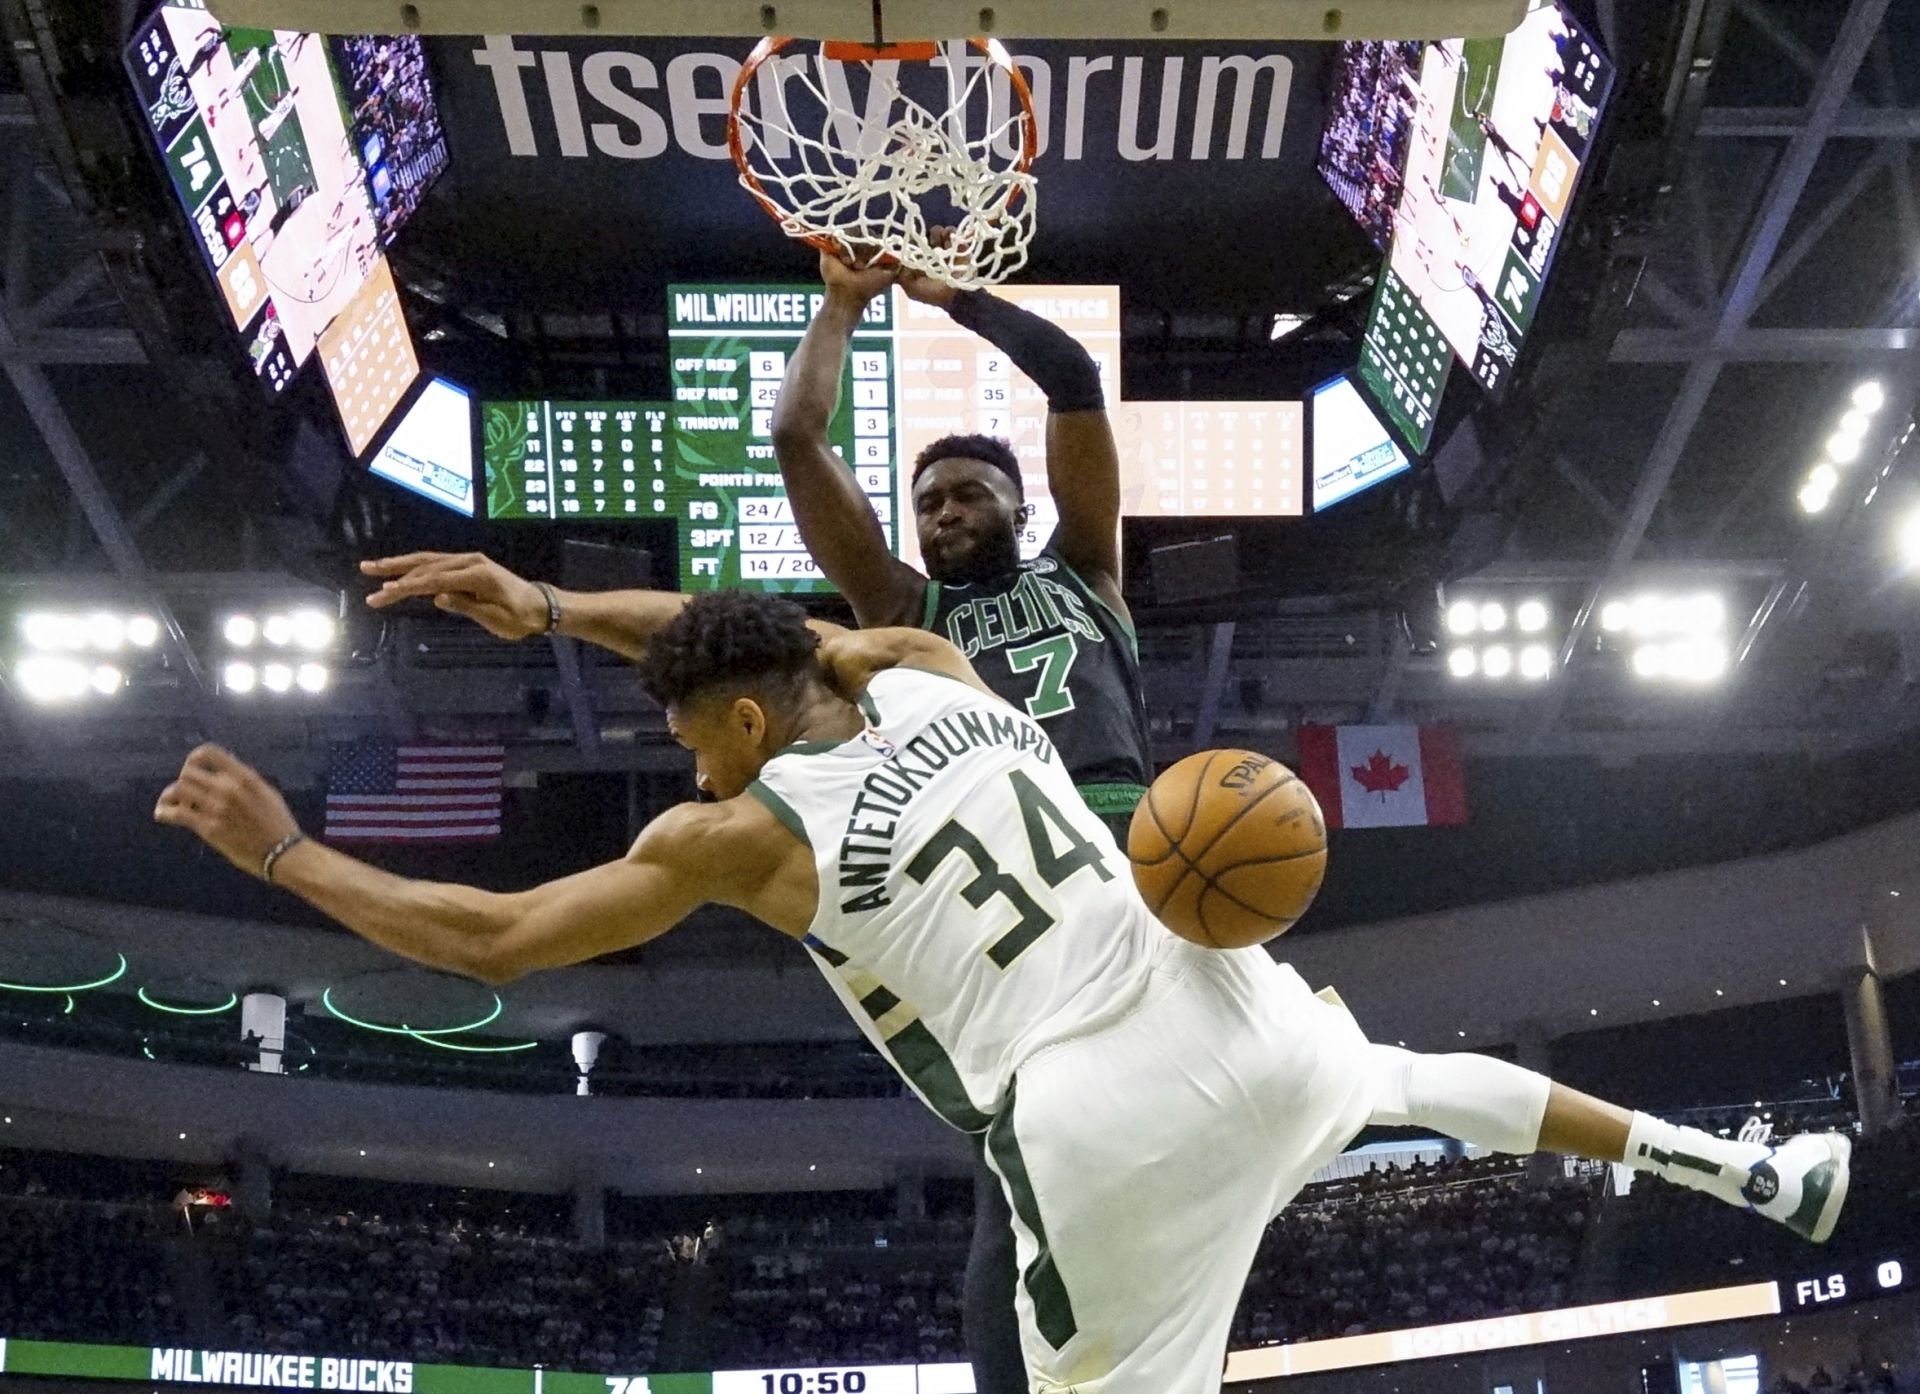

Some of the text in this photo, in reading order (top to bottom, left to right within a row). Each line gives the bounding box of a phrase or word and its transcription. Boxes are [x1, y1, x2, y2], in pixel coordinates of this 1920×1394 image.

[472, 35, 1294, 162] fiserv forum
[180, 135, 212, 192] 74
[197, 205, 228, 267] 10:50
[1528, 215, 1555, 274] 10:50
[1503, 266, 1530, 314] 74
[675, 293, 806, 322] MILWAUKEE
[675, 358, 704, 372] OFF
[762, 361, 773, 372] 6
[862, 361, 879, 372] 15
[988, 361, 998, 372] 2
[868, 390, 874, 400] 1
[984, 389, 1004, 400] 35
[867, 418, 877, 430] 3
[991, 418, 998, 429] 7
[526, 439, 541, 453] 11
[621, 439, 634, 453] 0
[868, 446, 878, 457] 6
[592, 459, 604, 472] 7
[653, 459, 662, 472] 1
[623, 479, 636, 493] 0
[653, 479, 665, 493] 0
[868, 475, 879, 486] 6
[526, 499, 548, 513] 34
[594, 499, 606, 512] 7
[653, 498, 666, 512] 0
[689, 501, 719, 520] FG
[745, 504, 769, 517] 24
[690, 528, 735, 547] 3PT
[750, 533, 768, 545] 12
[691, 557, 720, 576] FT
[750, 560, 769, 572] 14
[946, 571, 1104, 660] CELTICS
[1006, 631, 1082, 720] 7
[839, 710, 1056, 916] ANTETOKOUNMPO
[903, 768, 1116, 972] 34
[1796, 1260, 1903, 1305] FLS 0
[151, 1347, 414, 1394] MILWAUKEE BUCKS
[761, 1370, 867, 1394] 10:50
